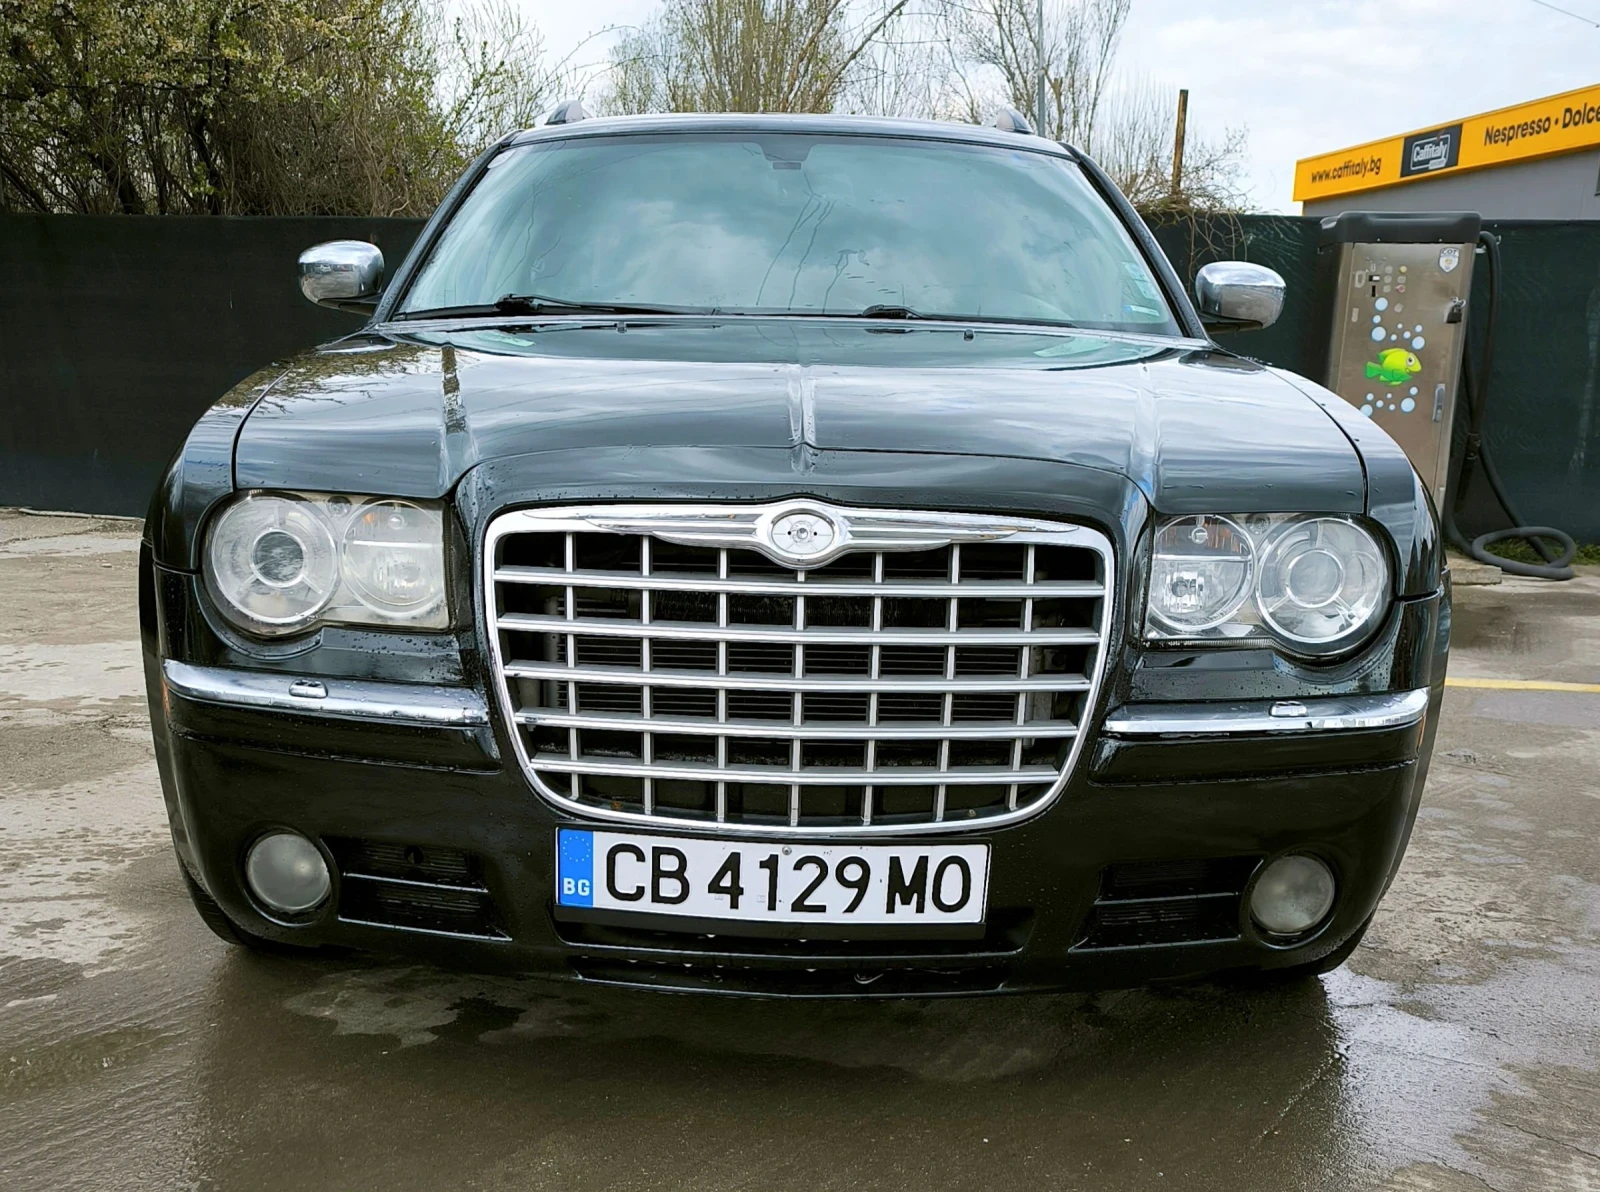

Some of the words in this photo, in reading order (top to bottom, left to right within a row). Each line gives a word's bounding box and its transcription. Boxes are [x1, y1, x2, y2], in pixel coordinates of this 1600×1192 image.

[1484, 116, 1551, 146] Nespresso
[1413, 140, 1448, 162] Caffitaly
[1311, 155, 1382, 184] www.caffitaly.bg
[563, 877, 590, 897] BG
[606, 843, 690, 905] CB
[707, 852, 871, 914] 4129
[886, 855, 972, 914] MO
